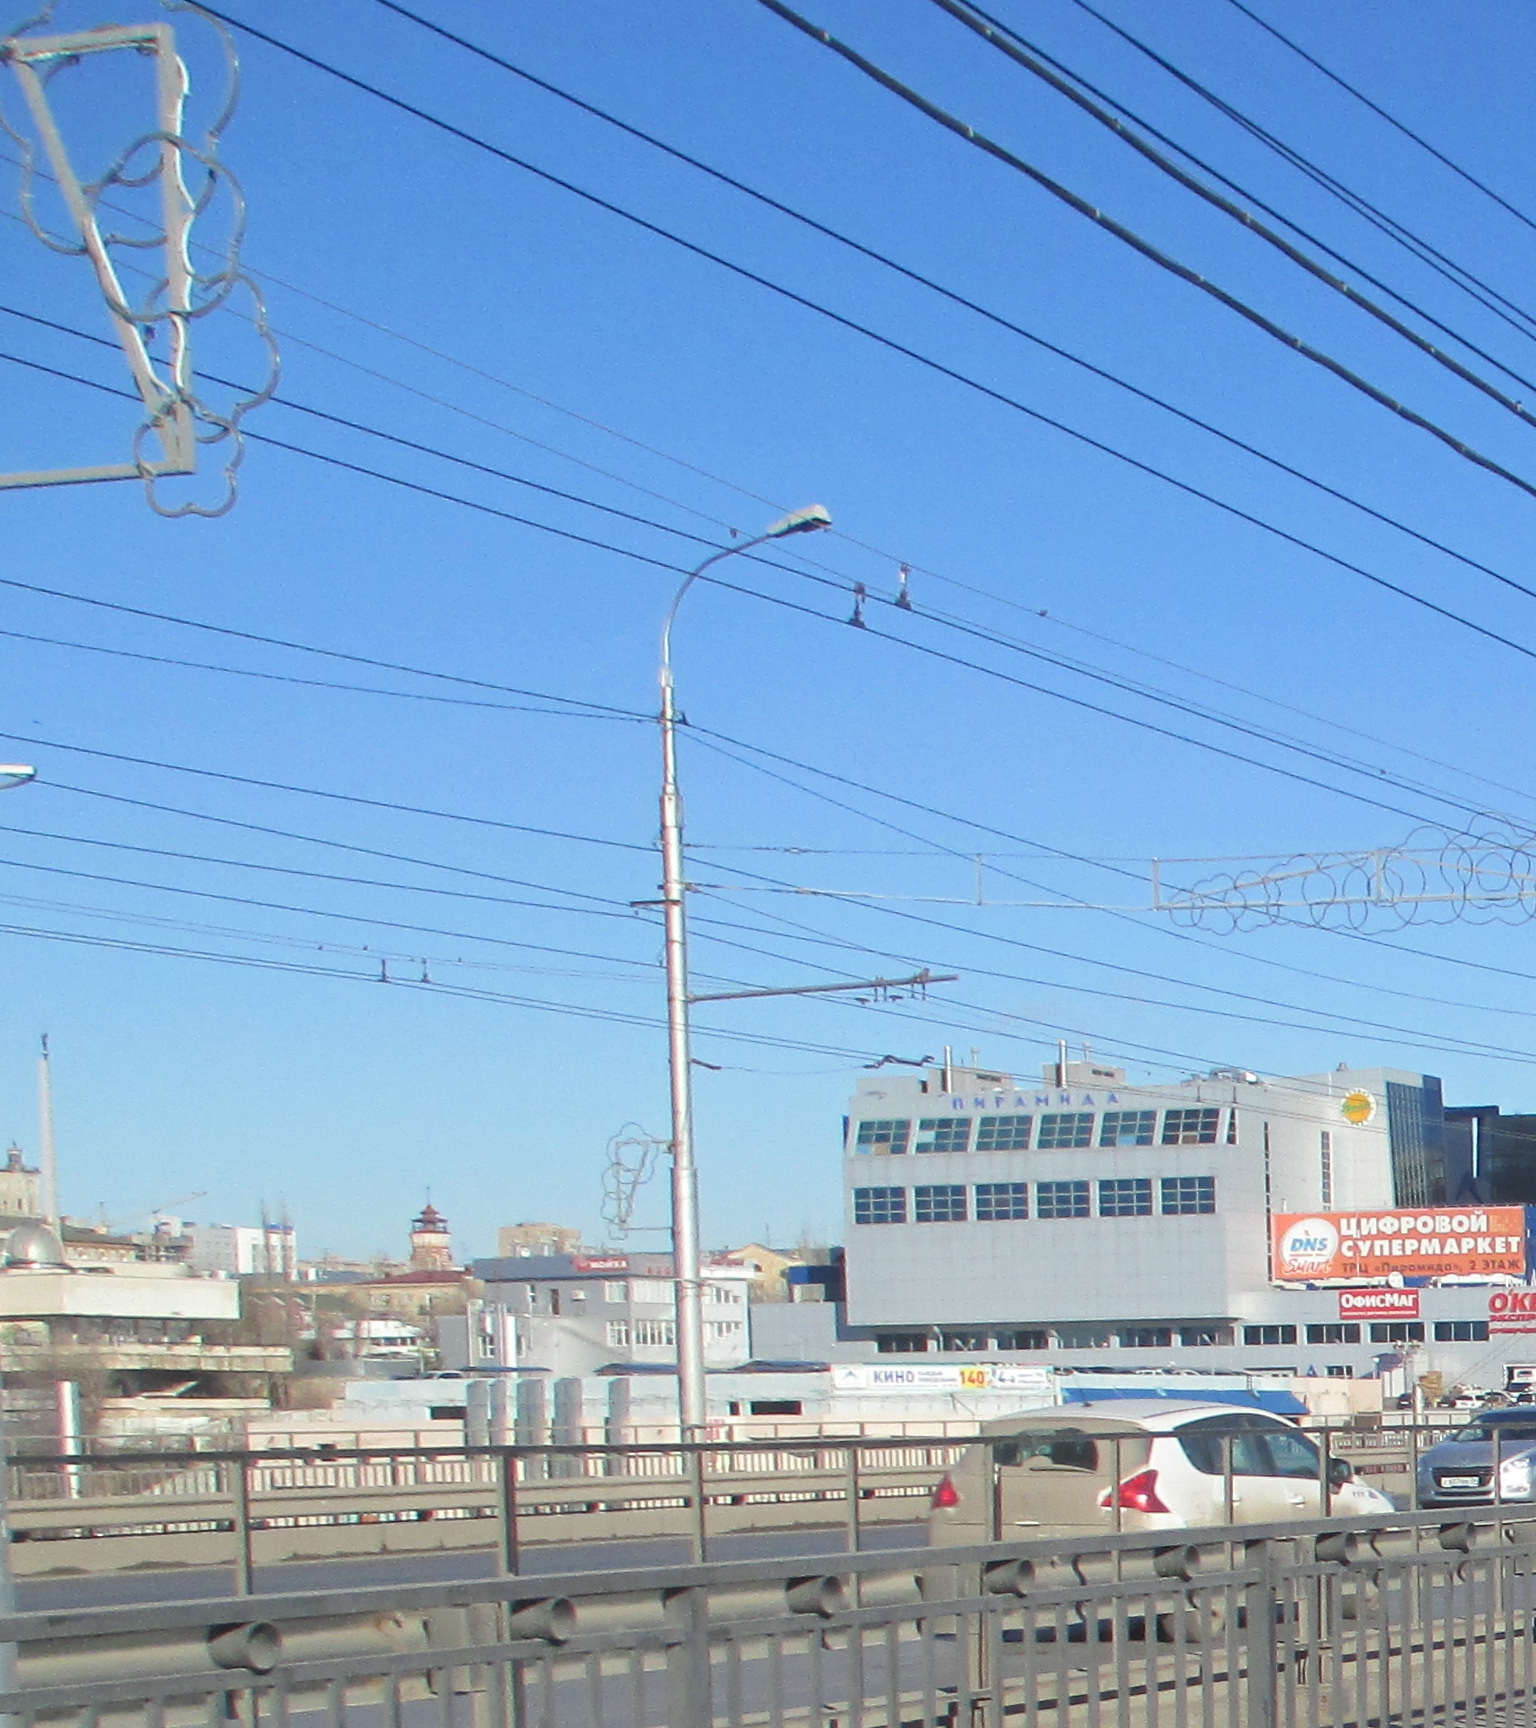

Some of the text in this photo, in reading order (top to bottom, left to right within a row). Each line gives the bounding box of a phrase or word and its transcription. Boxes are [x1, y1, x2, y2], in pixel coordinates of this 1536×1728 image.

[1340, 1210, 1488, 1238] ЦИФРОВОЙ
[1290, 1237, 1328, 1251] DNS
[1341, 1236, 1521, 1258] СУПЕРМАРКЕТ
[1469, 1260, 1477, 1271] 2
[1482, 1259, 1522, 1270] ЭТАЖ
[873, 1370, 914, 1383] КИНО
[960, 1370, 985, 1384] 140
